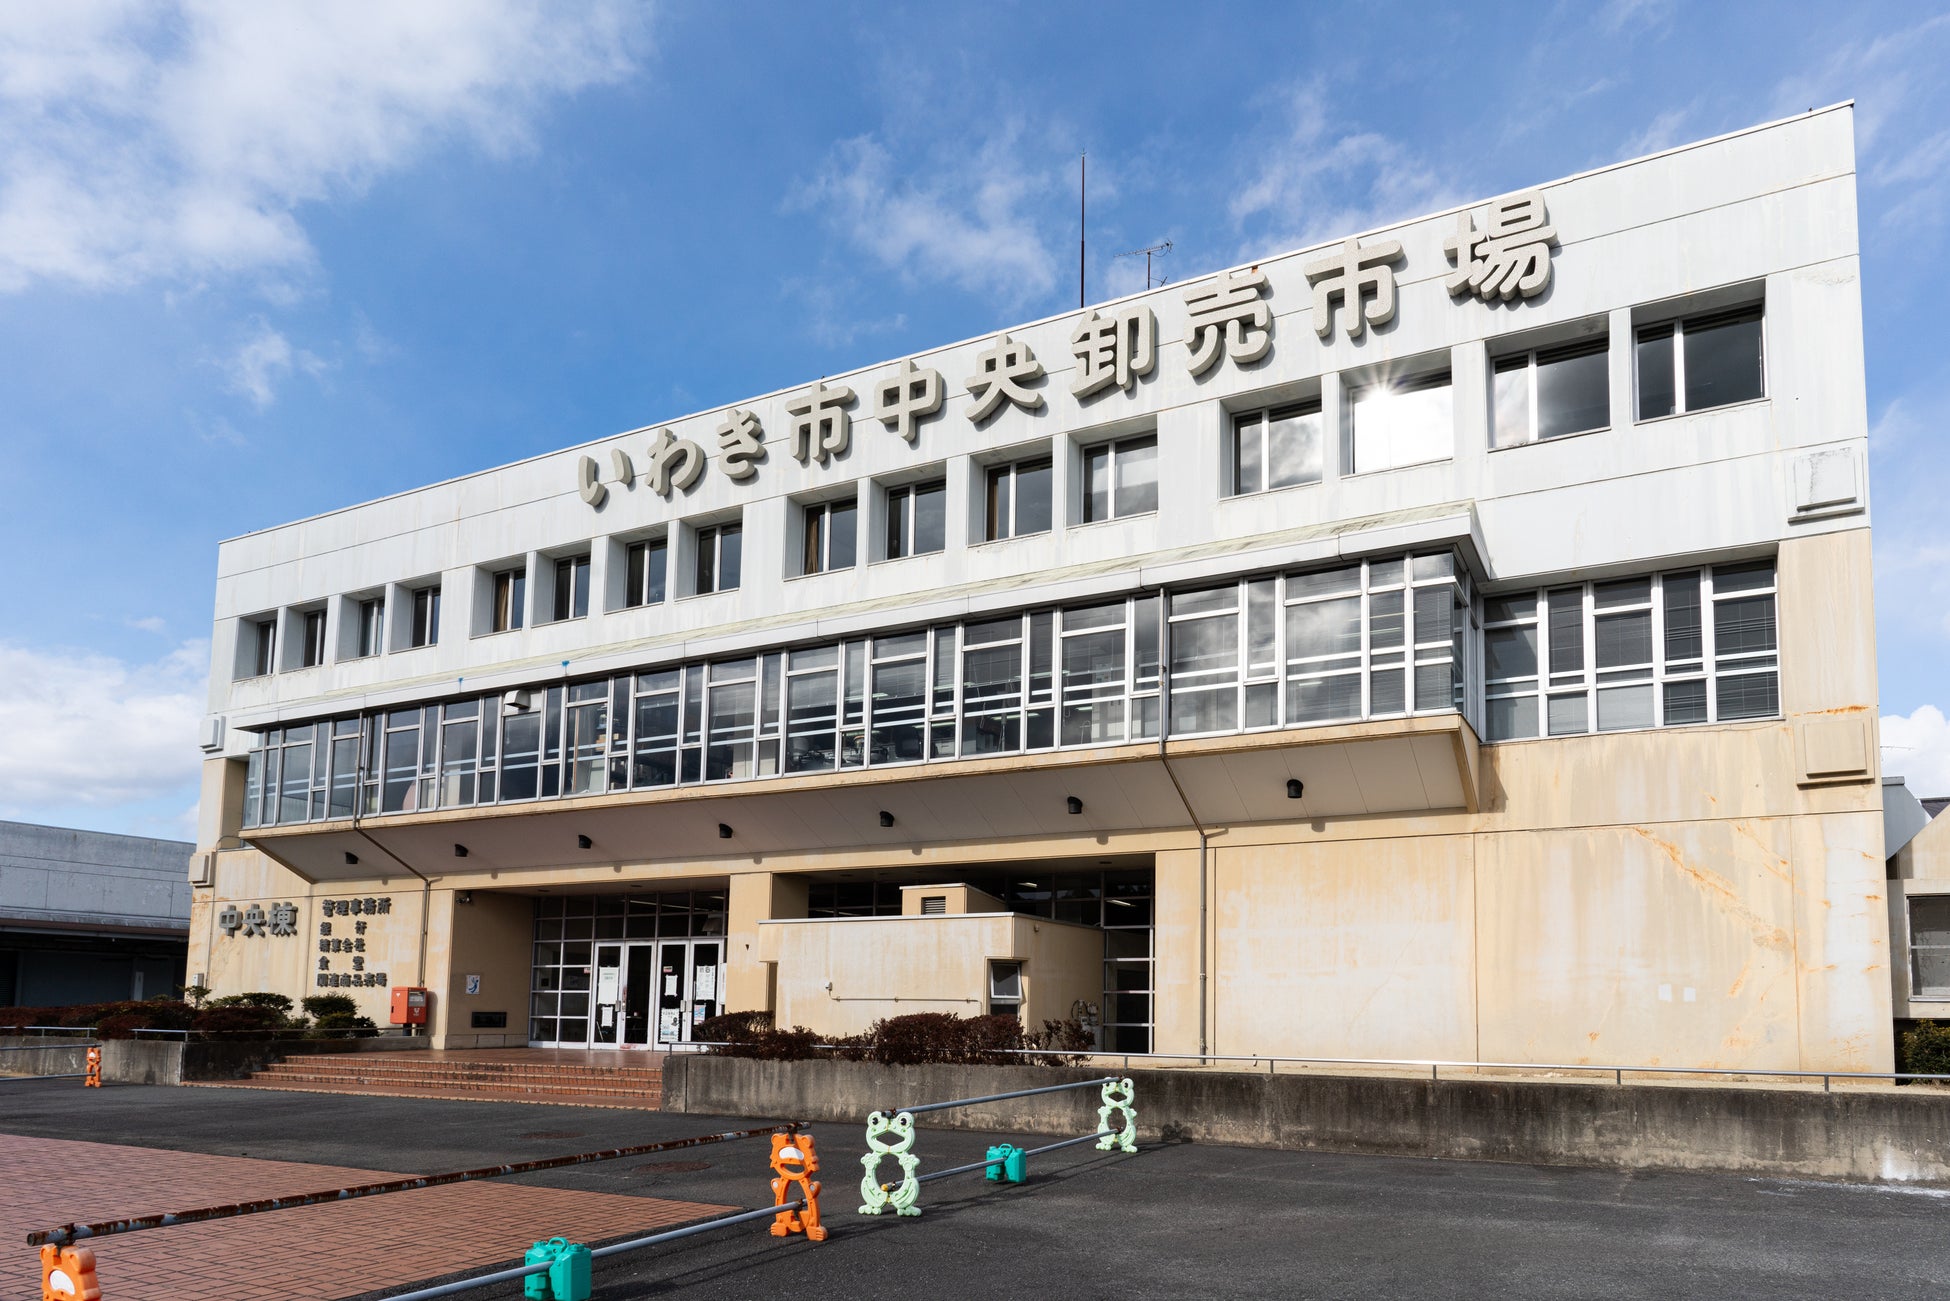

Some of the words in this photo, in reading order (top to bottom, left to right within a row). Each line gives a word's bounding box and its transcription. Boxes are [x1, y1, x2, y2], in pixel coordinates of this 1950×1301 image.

[578, 189, 1557, 507] いわき市中央卸売市場
[219, 902, 298, 937] 中央棟
[323, 898, 391, 917] 管理事務所
